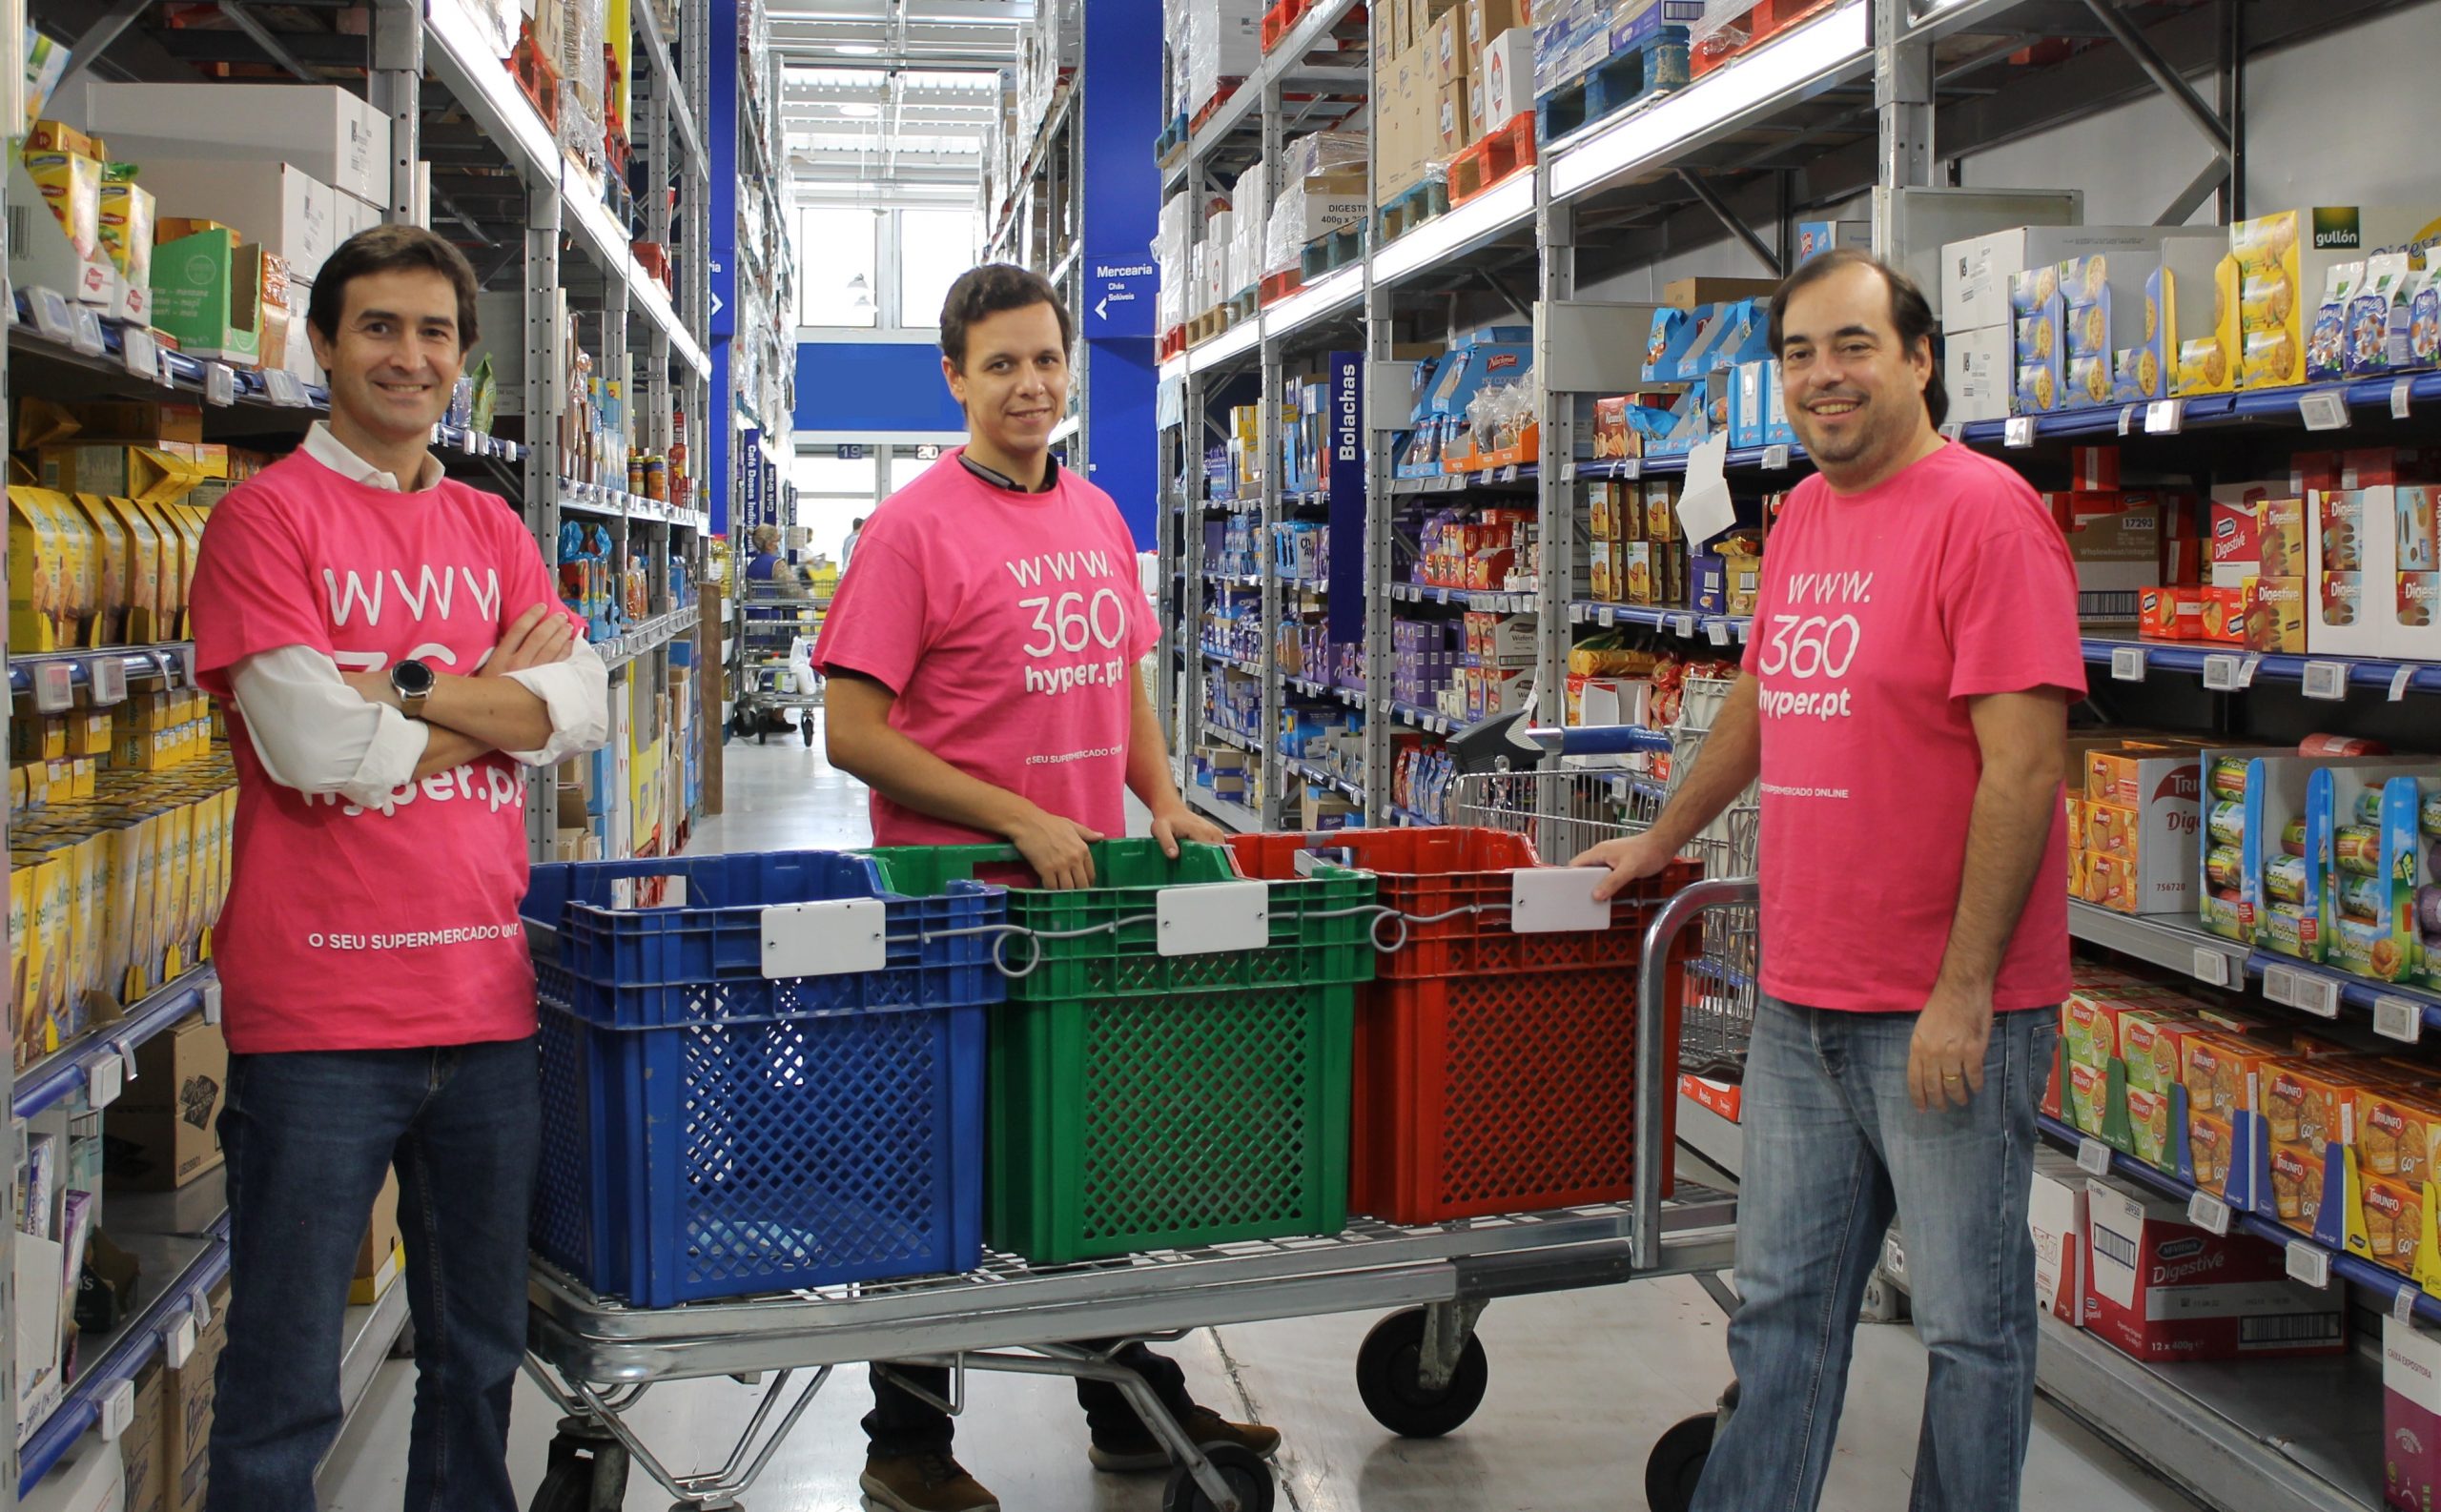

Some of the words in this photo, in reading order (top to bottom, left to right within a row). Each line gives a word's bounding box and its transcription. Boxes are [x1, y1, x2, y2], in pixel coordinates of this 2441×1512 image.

[1322, 215, 1343, 225] 400g
[2316, 230, 2357, 247] gullón
[1097, 263, 1153, 278] Mercearia
[1339, 363, 1356, 460] Bolachas
[748, 444, 757, 468] Café
[839, 445, 860, 459] 19
[917, 445, 939, 460] 20
[748, 470, 757, 500] Doses
[2124, 518, 2154, 528] 17293
[2268, 510, 2300, 529] Digestive
[2215, 530, 2246, 560] Digestive
[2259, 586, 2300, 605] Digestive
[1018, 588, 1125, 658] 360
[1511, 634, 1534, 643] Wafers
[1759, 613, 1860, 679] 360
[1024, 656, 1124, 696] hyper.pt
[1758, 682, 1852, 722] hyper.pt
[1815, 787, 1850, 799] ONLINE
[2156, 883, 2185, 891] 756720
[309, 933, 324, 948] O
[329, 934, 366, 950] SEU
[371, 925, 500, 950] SUPERMERCADO
[2072, 1006, 2091, 1022] TRIUNFO
[2130, 1028, 2151, 1046] TRIUNFO
[2194, 1050, 2216, 1069] TRIUNFO
[2071, 1071, 2091, 1089] TRIUNFO
[2275, 1077, 2303, 1099] TRIUNFO
[2129, 1096, 2150, 1115] TRIUNFO
[2372, 1107, 2402, 1131] TRIUNFO
[2194, 1121, 2216, 1142] TRIUNFO
[2300, 1123, 2314, 1141] GO!
[2276, 1154, 2304, 1176] TRIUNFO
[2400, 1156, 2417, 1175] GO!
[2302, 1200, 2316, 1218] GO!
[2369, 1186, 2400, 1213] TRIUNFO
[2397, 1238, 2413, 1257] GO!
[2153, 1251, 2225, 1284] Digestive
[2151, 1341, 2162, 1351] 12
[2172, 1340, 2193, 1351] 400g
[2387, 1348, 2401, 1364] CAIXA
[2401, 1355, 2431, 1379] EXPOSITORA
